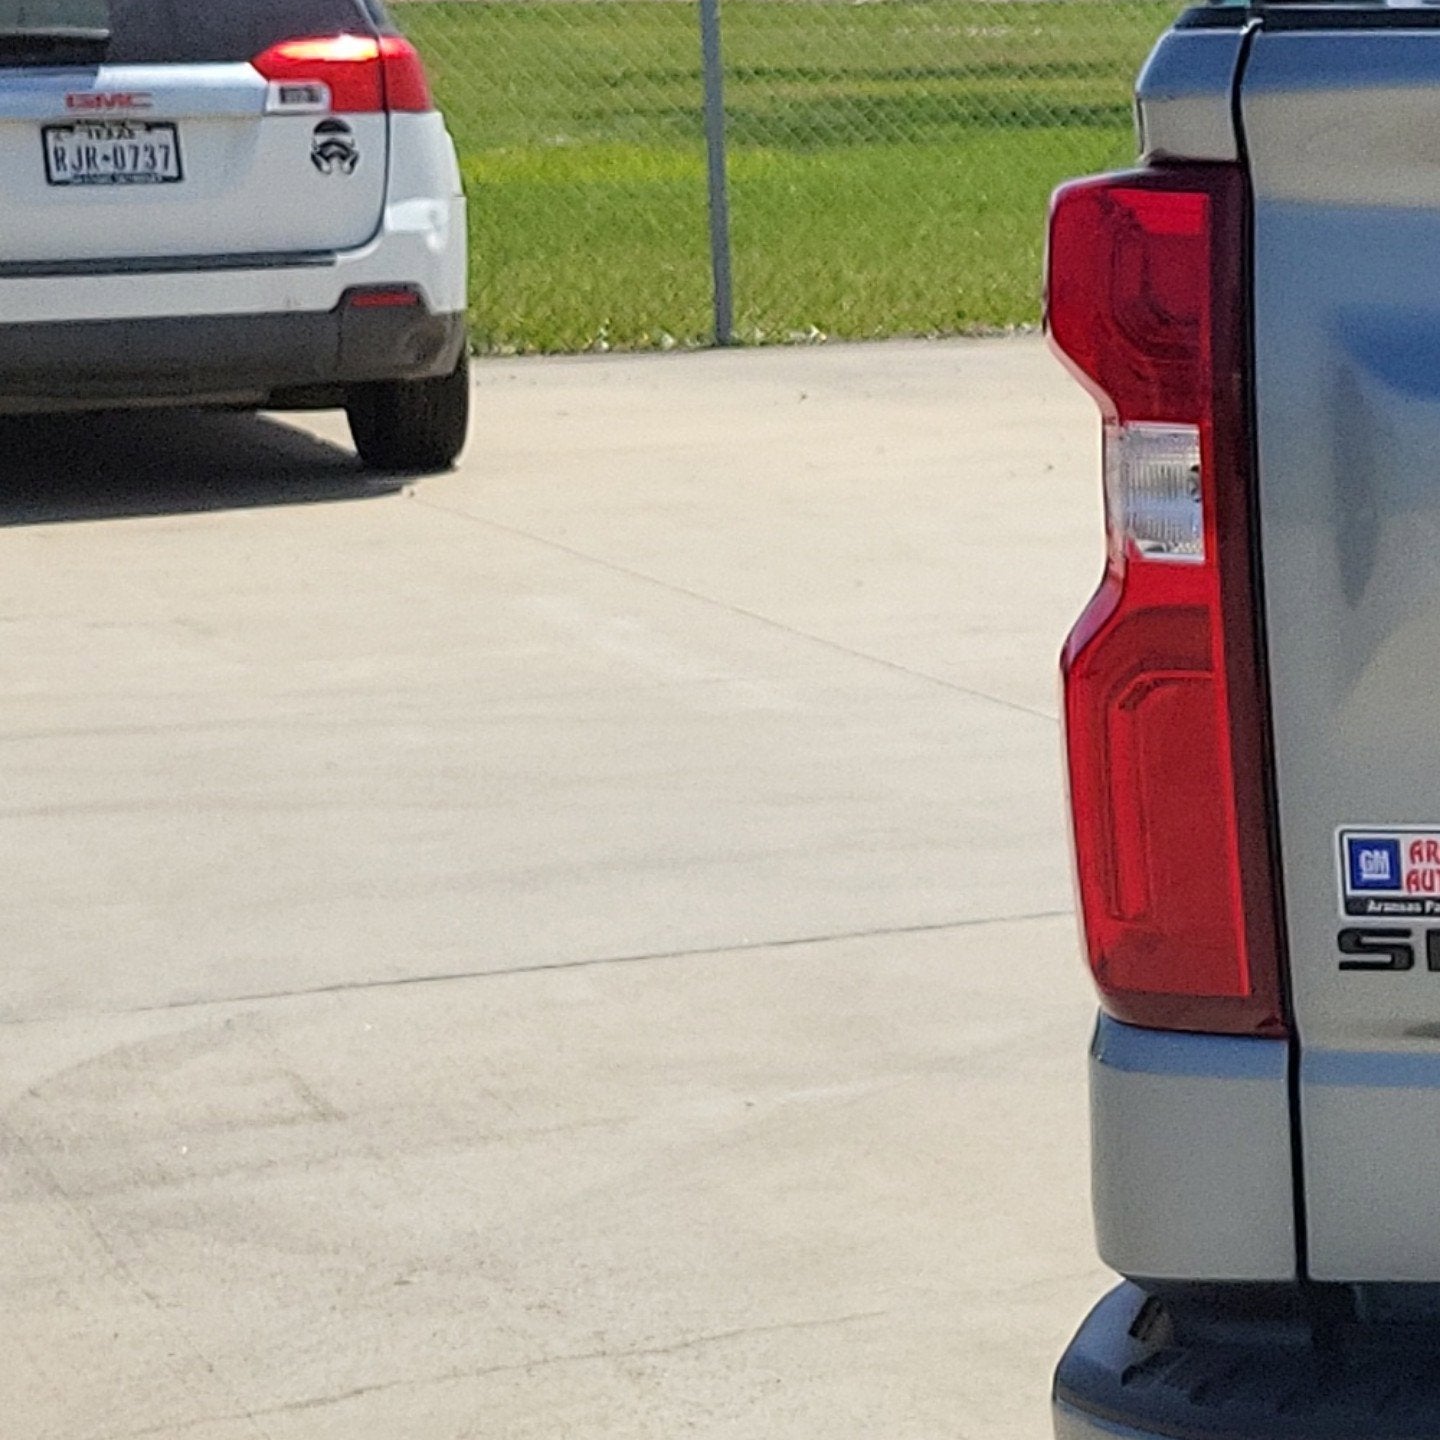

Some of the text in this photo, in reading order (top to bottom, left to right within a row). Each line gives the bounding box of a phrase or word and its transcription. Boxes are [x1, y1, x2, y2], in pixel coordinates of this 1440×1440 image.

[64, 92, 153, 109] GMC
[1359, 850, 1391, 881] GM
[1367, 899, 1422, 914] Aransas
